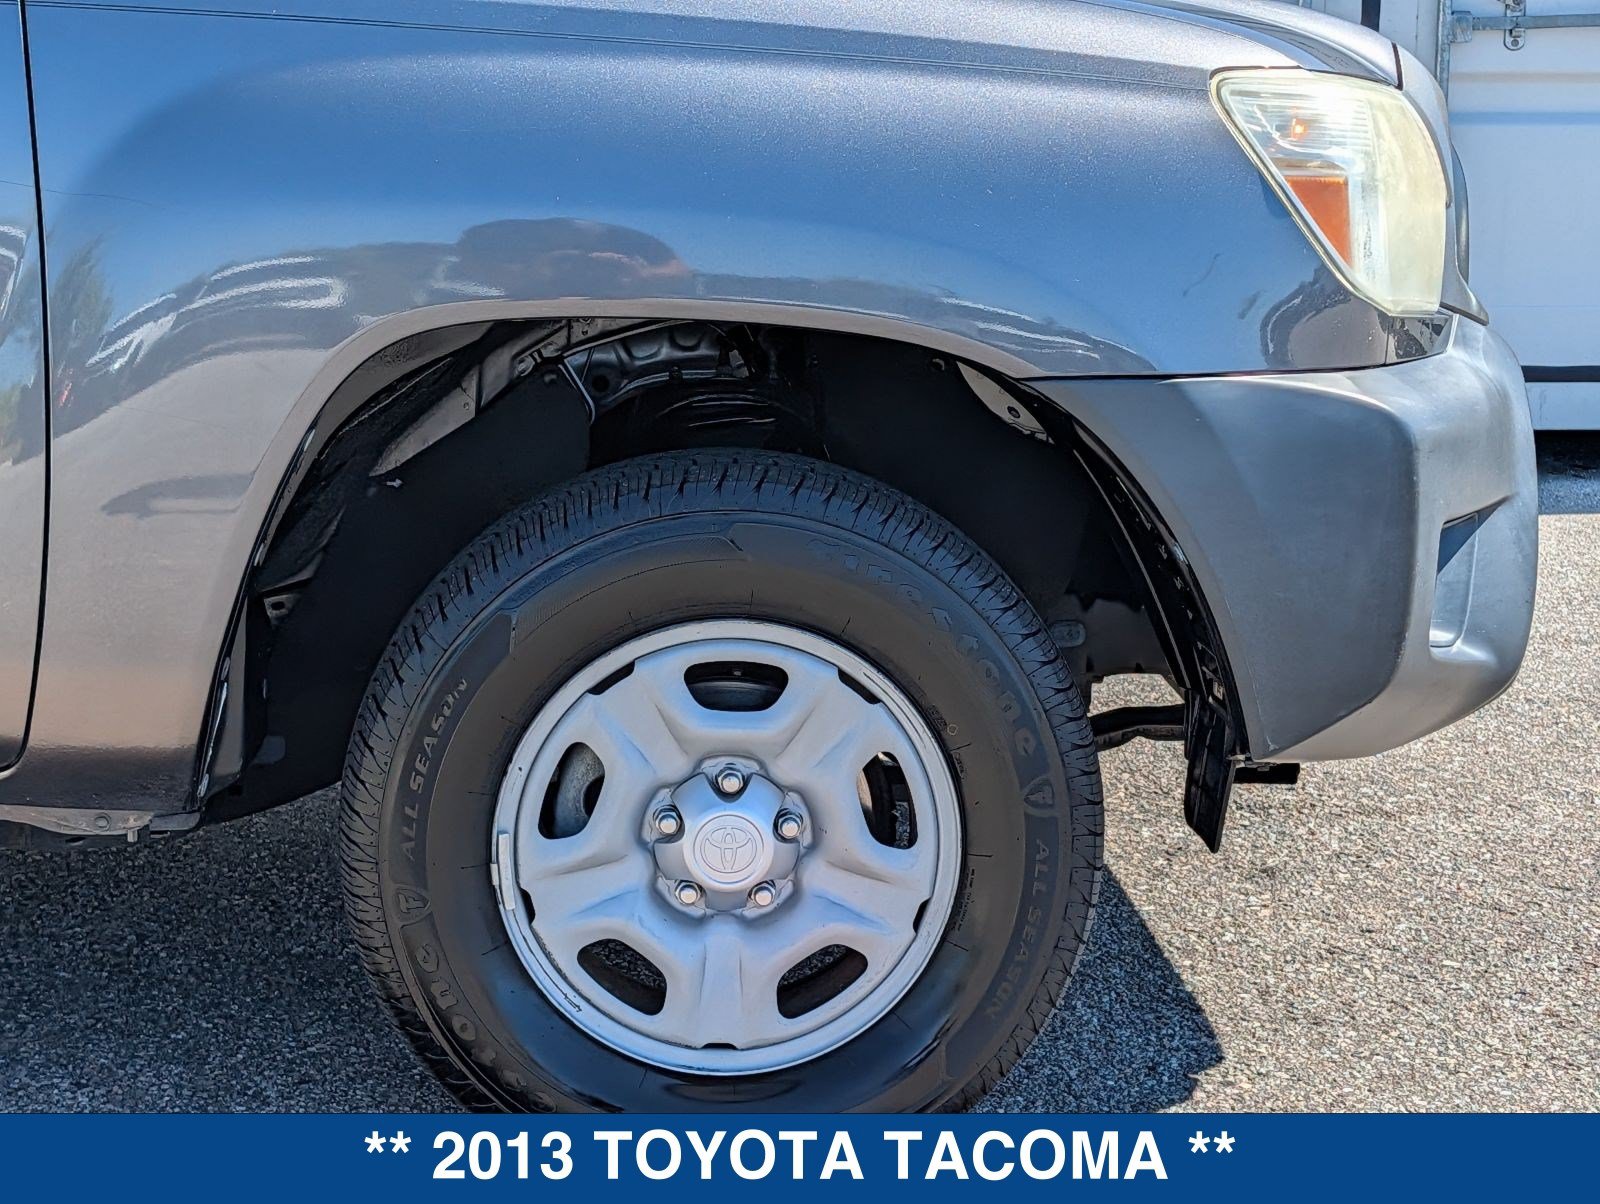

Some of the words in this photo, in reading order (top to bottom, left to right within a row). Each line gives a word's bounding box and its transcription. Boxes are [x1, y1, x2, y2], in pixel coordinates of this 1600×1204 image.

[409, 678, 468, 794] SEASON
[400, 801, 420, 862] ALL
[1033, 838, 1051, 897] ALL
[985, 904, 1042, 1018] SEASON
